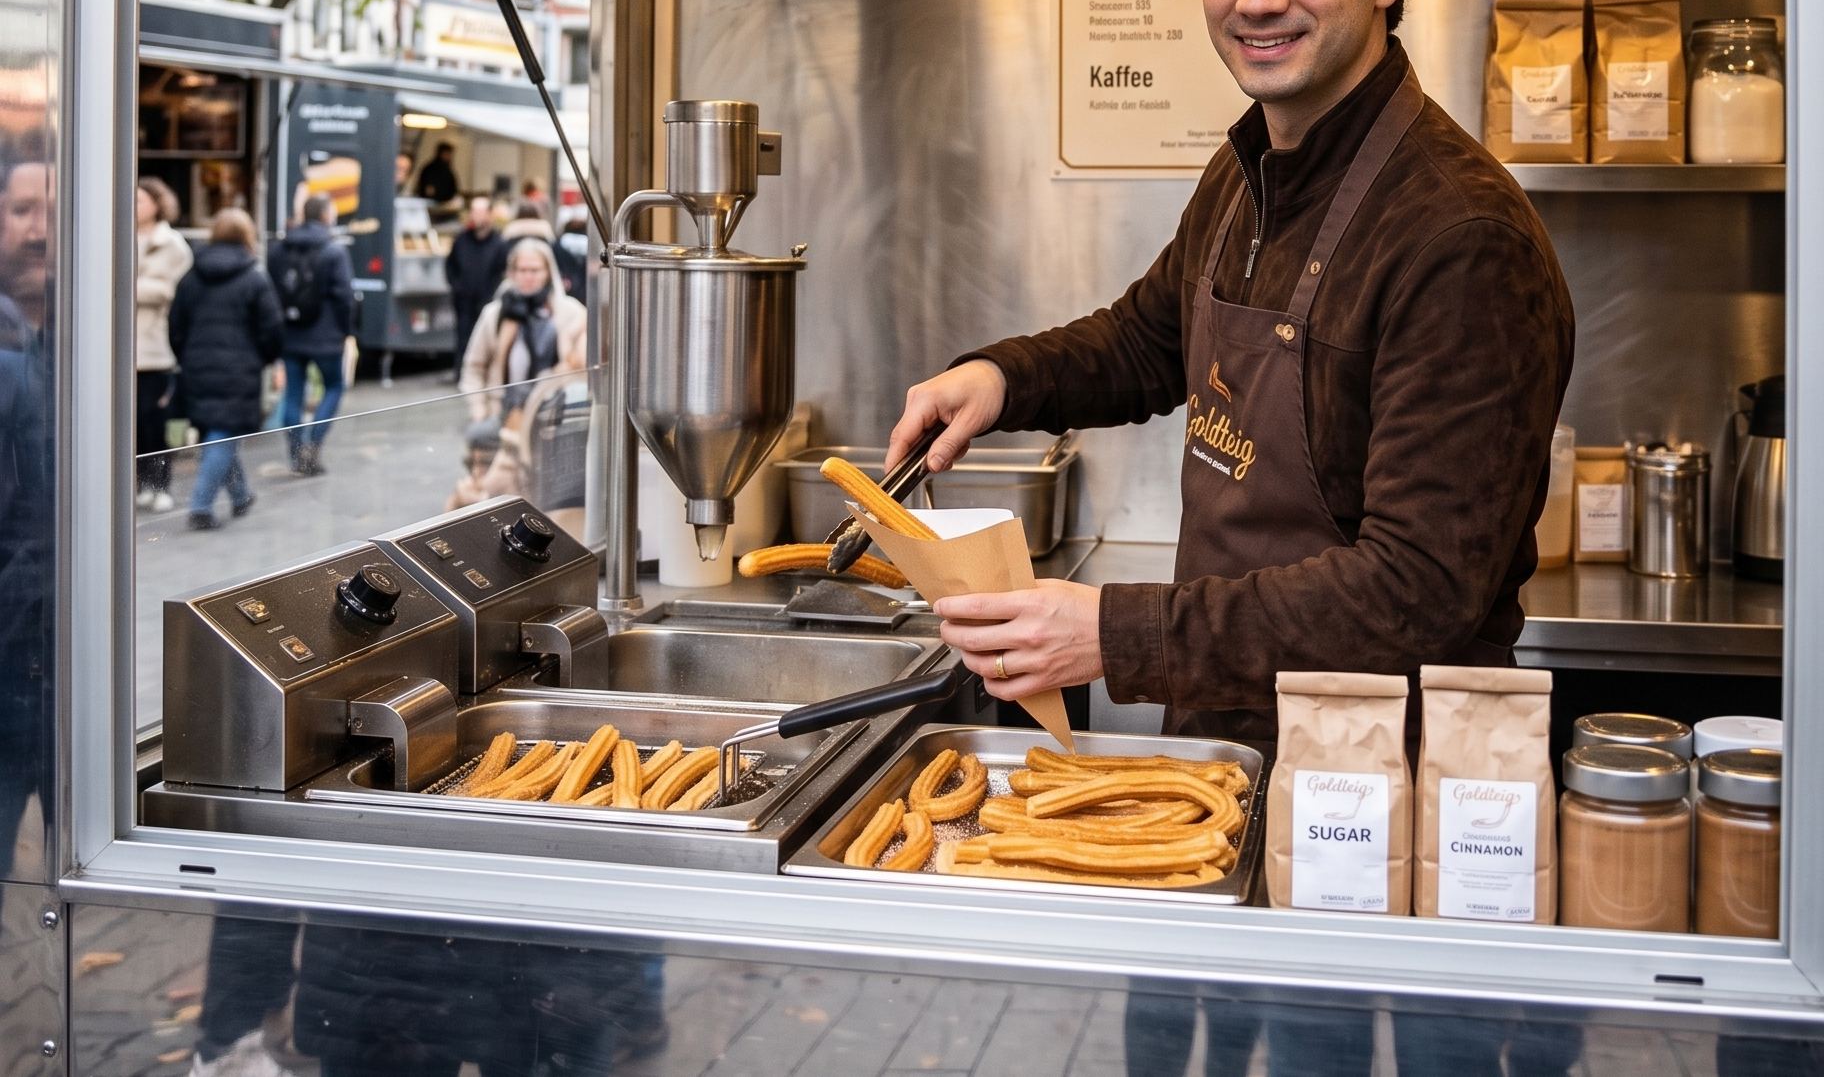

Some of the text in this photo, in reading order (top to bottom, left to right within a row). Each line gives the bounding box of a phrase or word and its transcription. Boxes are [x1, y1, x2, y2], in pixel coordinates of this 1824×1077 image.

[1090, 65, 1153, 88] Kaffee
[1307, 775, 1374, 800] Goldteig
[1453, 783, 1520, 808] Goldteig
[1308, 825, 1371, 842] SUGAR
[1451, 841, 1523, 856] CINNAMON
